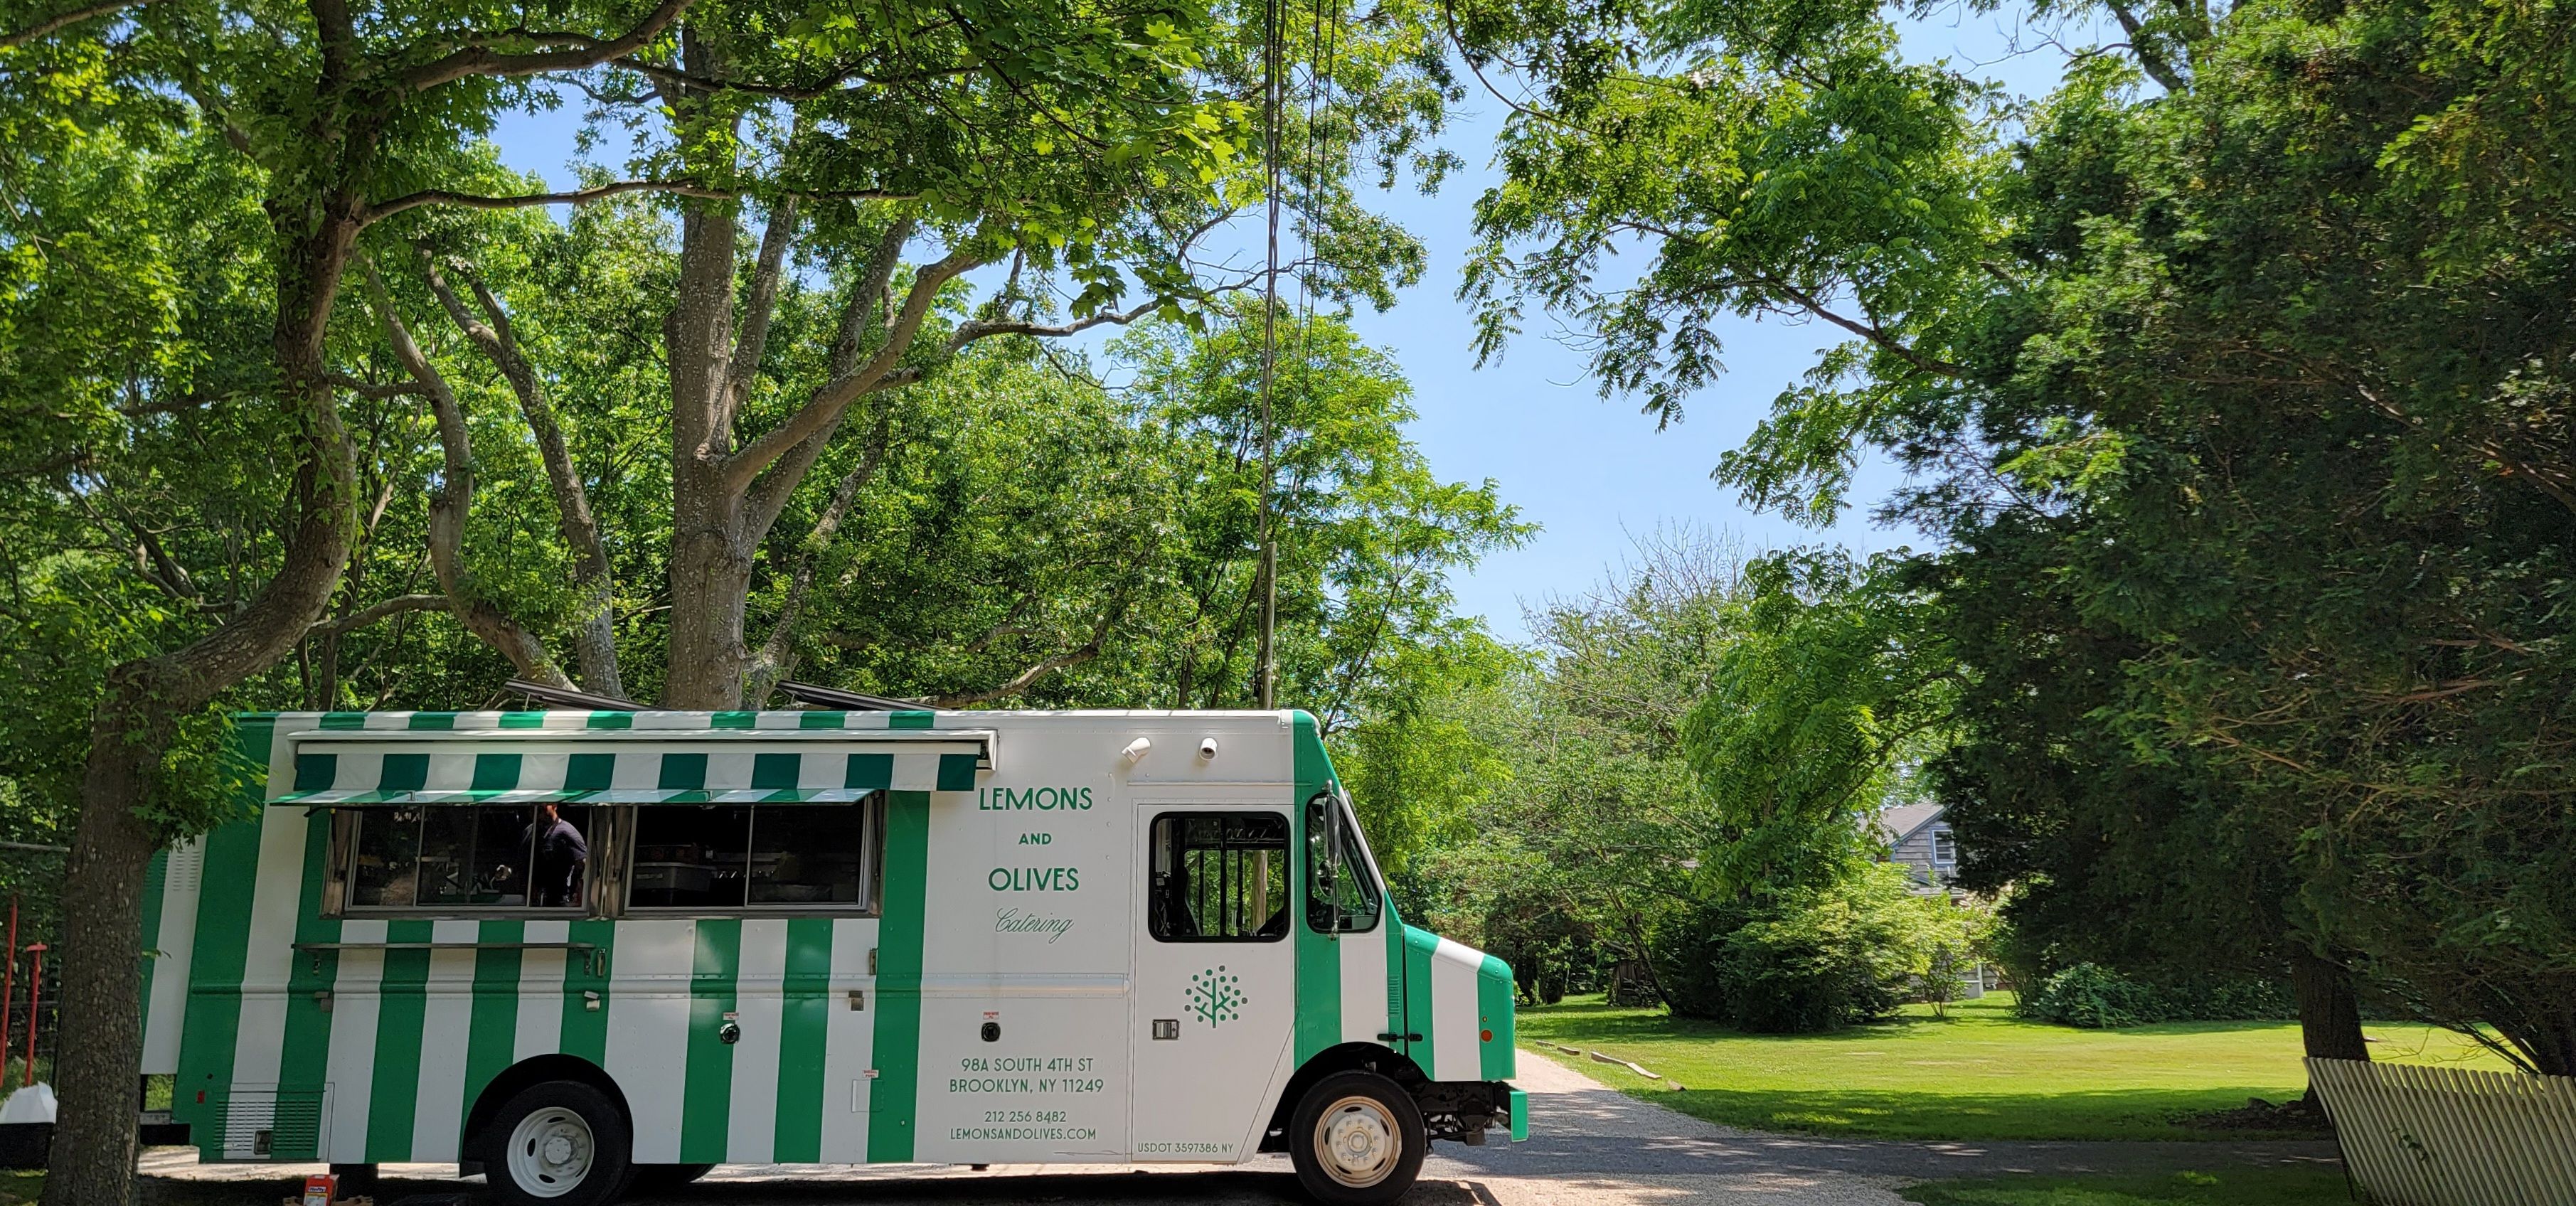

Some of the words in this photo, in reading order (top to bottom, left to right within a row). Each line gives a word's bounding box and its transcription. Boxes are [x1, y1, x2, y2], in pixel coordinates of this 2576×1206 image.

[979, 786, 1092, 811] LEMONS
[1018, 833, 1052, 845] AND
[989, 868, 1079, 892] OLIVES
[995, 907, 1075, 944] Catering
[962, 1057, 989, 1072] 98A
[994, 1057, 1042, 1072] SOUTH
[1047, 1057, 1073, 1072] 4TH
[1077, 1057, 1094, 1072] ST
[949, 1078, 1033, 1094] BROOKLYN,
[1039, 1079, 1057, 1093] NY
[1062, 1079, 1104, 1093] 11249
[984, 1111, 1005, 1123] 212
[1008, 1111, 1032, 1123] 256
[1036, 1111, 1067, 1123] 8482
[950, 1128, 1097, 1140] LEMONSANDOLIVES.COM
[1137, 1143, 1172, 1153] USDOT
[1174, 1143, 1218, 1153] 3597386
[1221, 1143, 1234, 1153] NY
